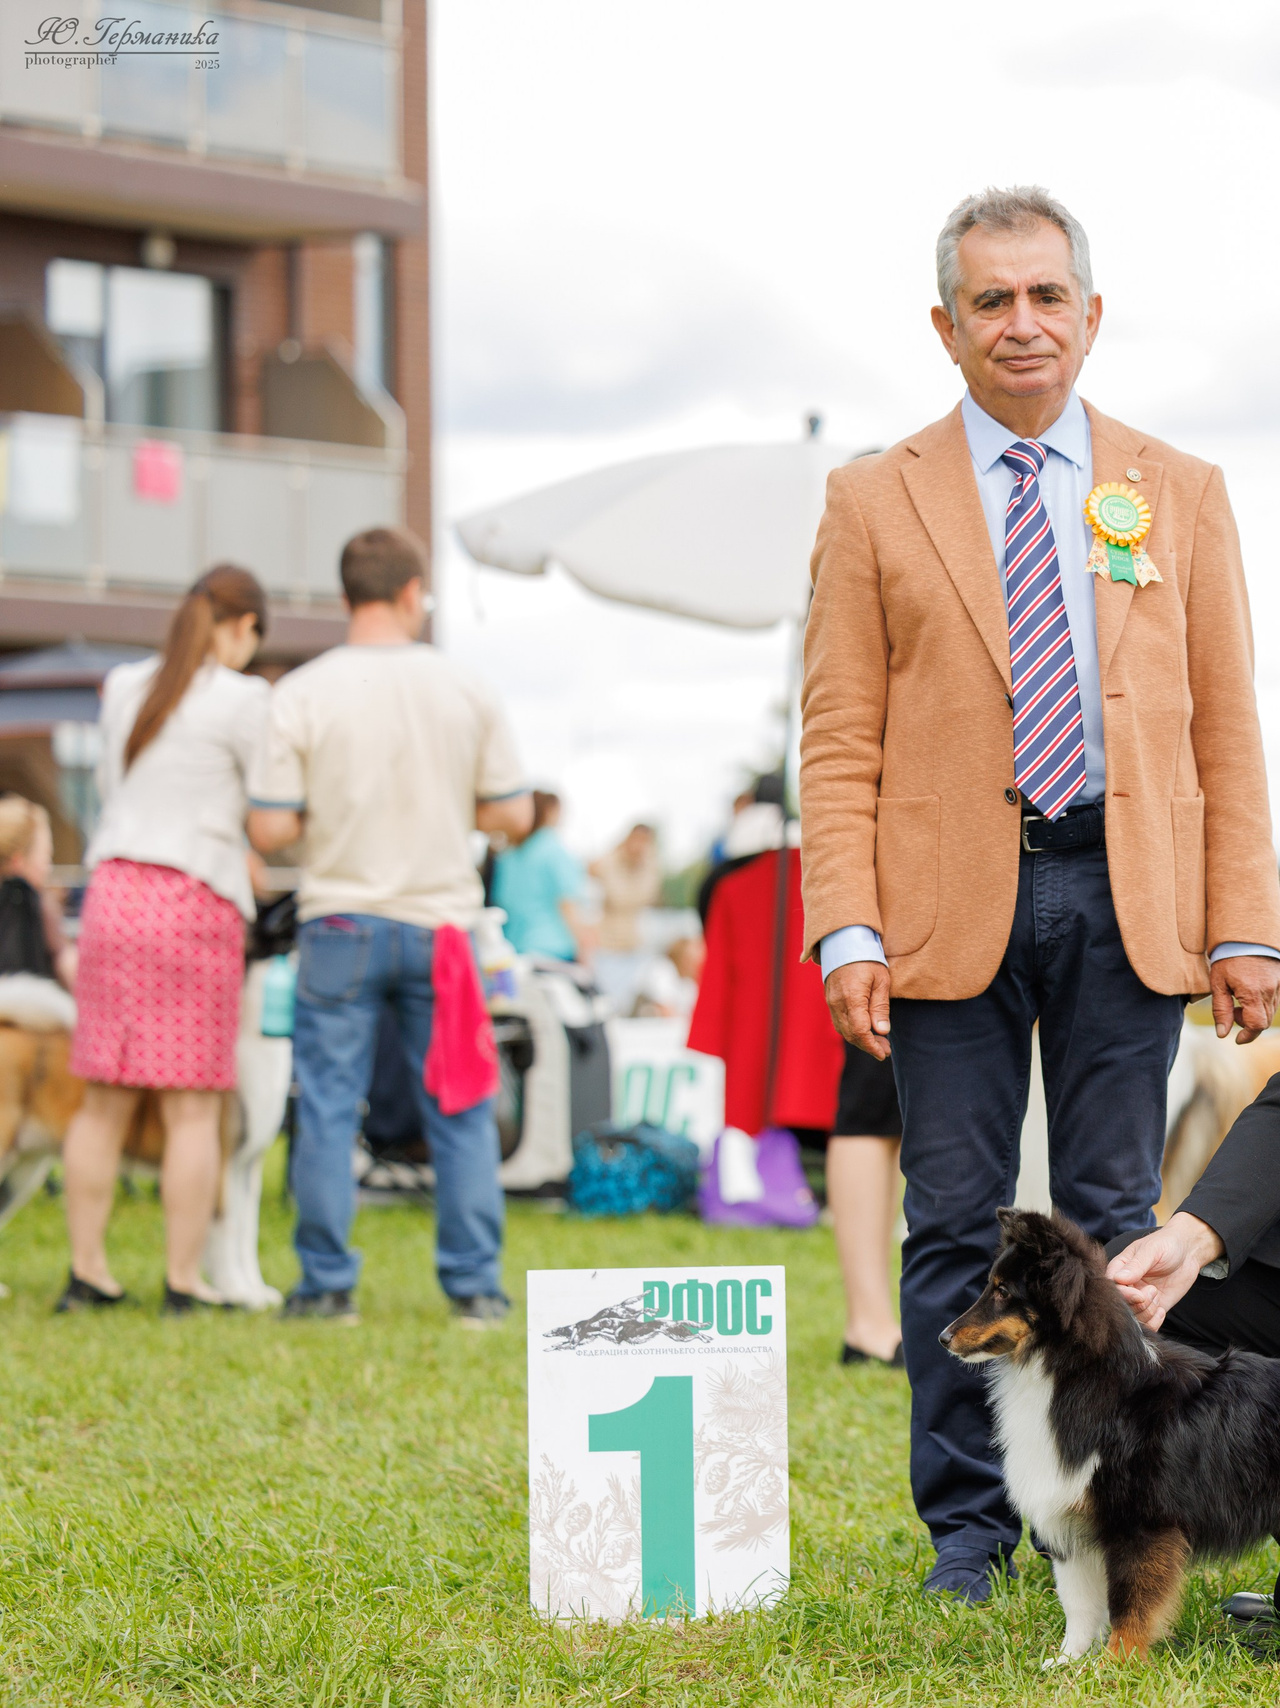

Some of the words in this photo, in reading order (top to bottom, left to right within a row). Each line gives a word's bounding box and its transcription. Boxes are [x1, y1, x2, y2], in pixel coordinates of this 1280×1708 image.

[643, 1278, 773, 1336] РФОС
[576, 1348, 629, 1357] ФЕДЕРАЦИЯ
[631, 1347, 696, 1357] ОХОТНИЧЬЕГО
[697, 1345, 774, 1356] СОБАКОВОДСТВА
[588, 1375, 696, 1619] 1
